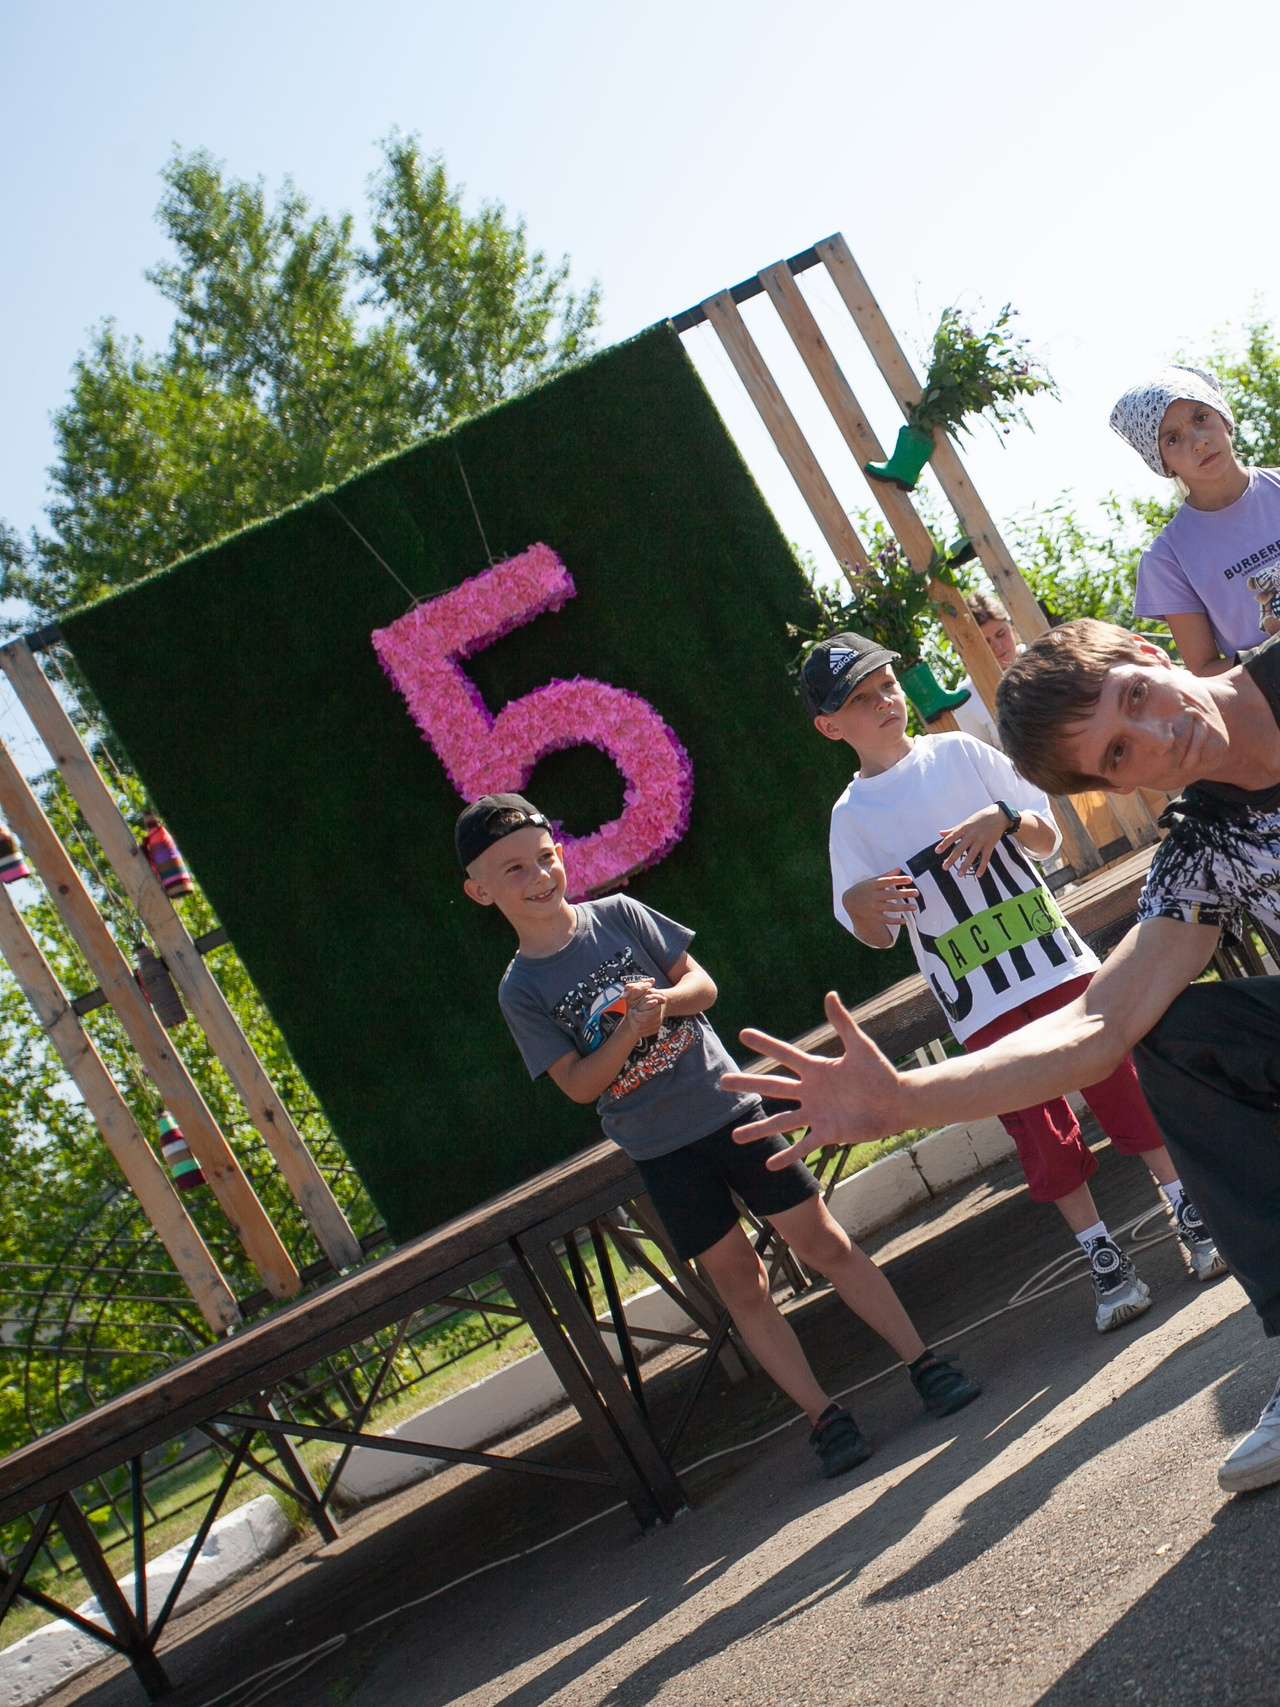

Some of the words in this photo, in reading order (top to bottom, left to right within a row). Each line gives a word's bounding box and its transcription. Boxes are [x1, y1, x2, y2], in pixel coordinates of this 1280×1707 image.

[1241, 562, 1261, 577] LONDON
[832, 649, 860, 675] adidas
[371, 541, 694, 903] 5
[610, 1029, 697, 1099] MONSTER
